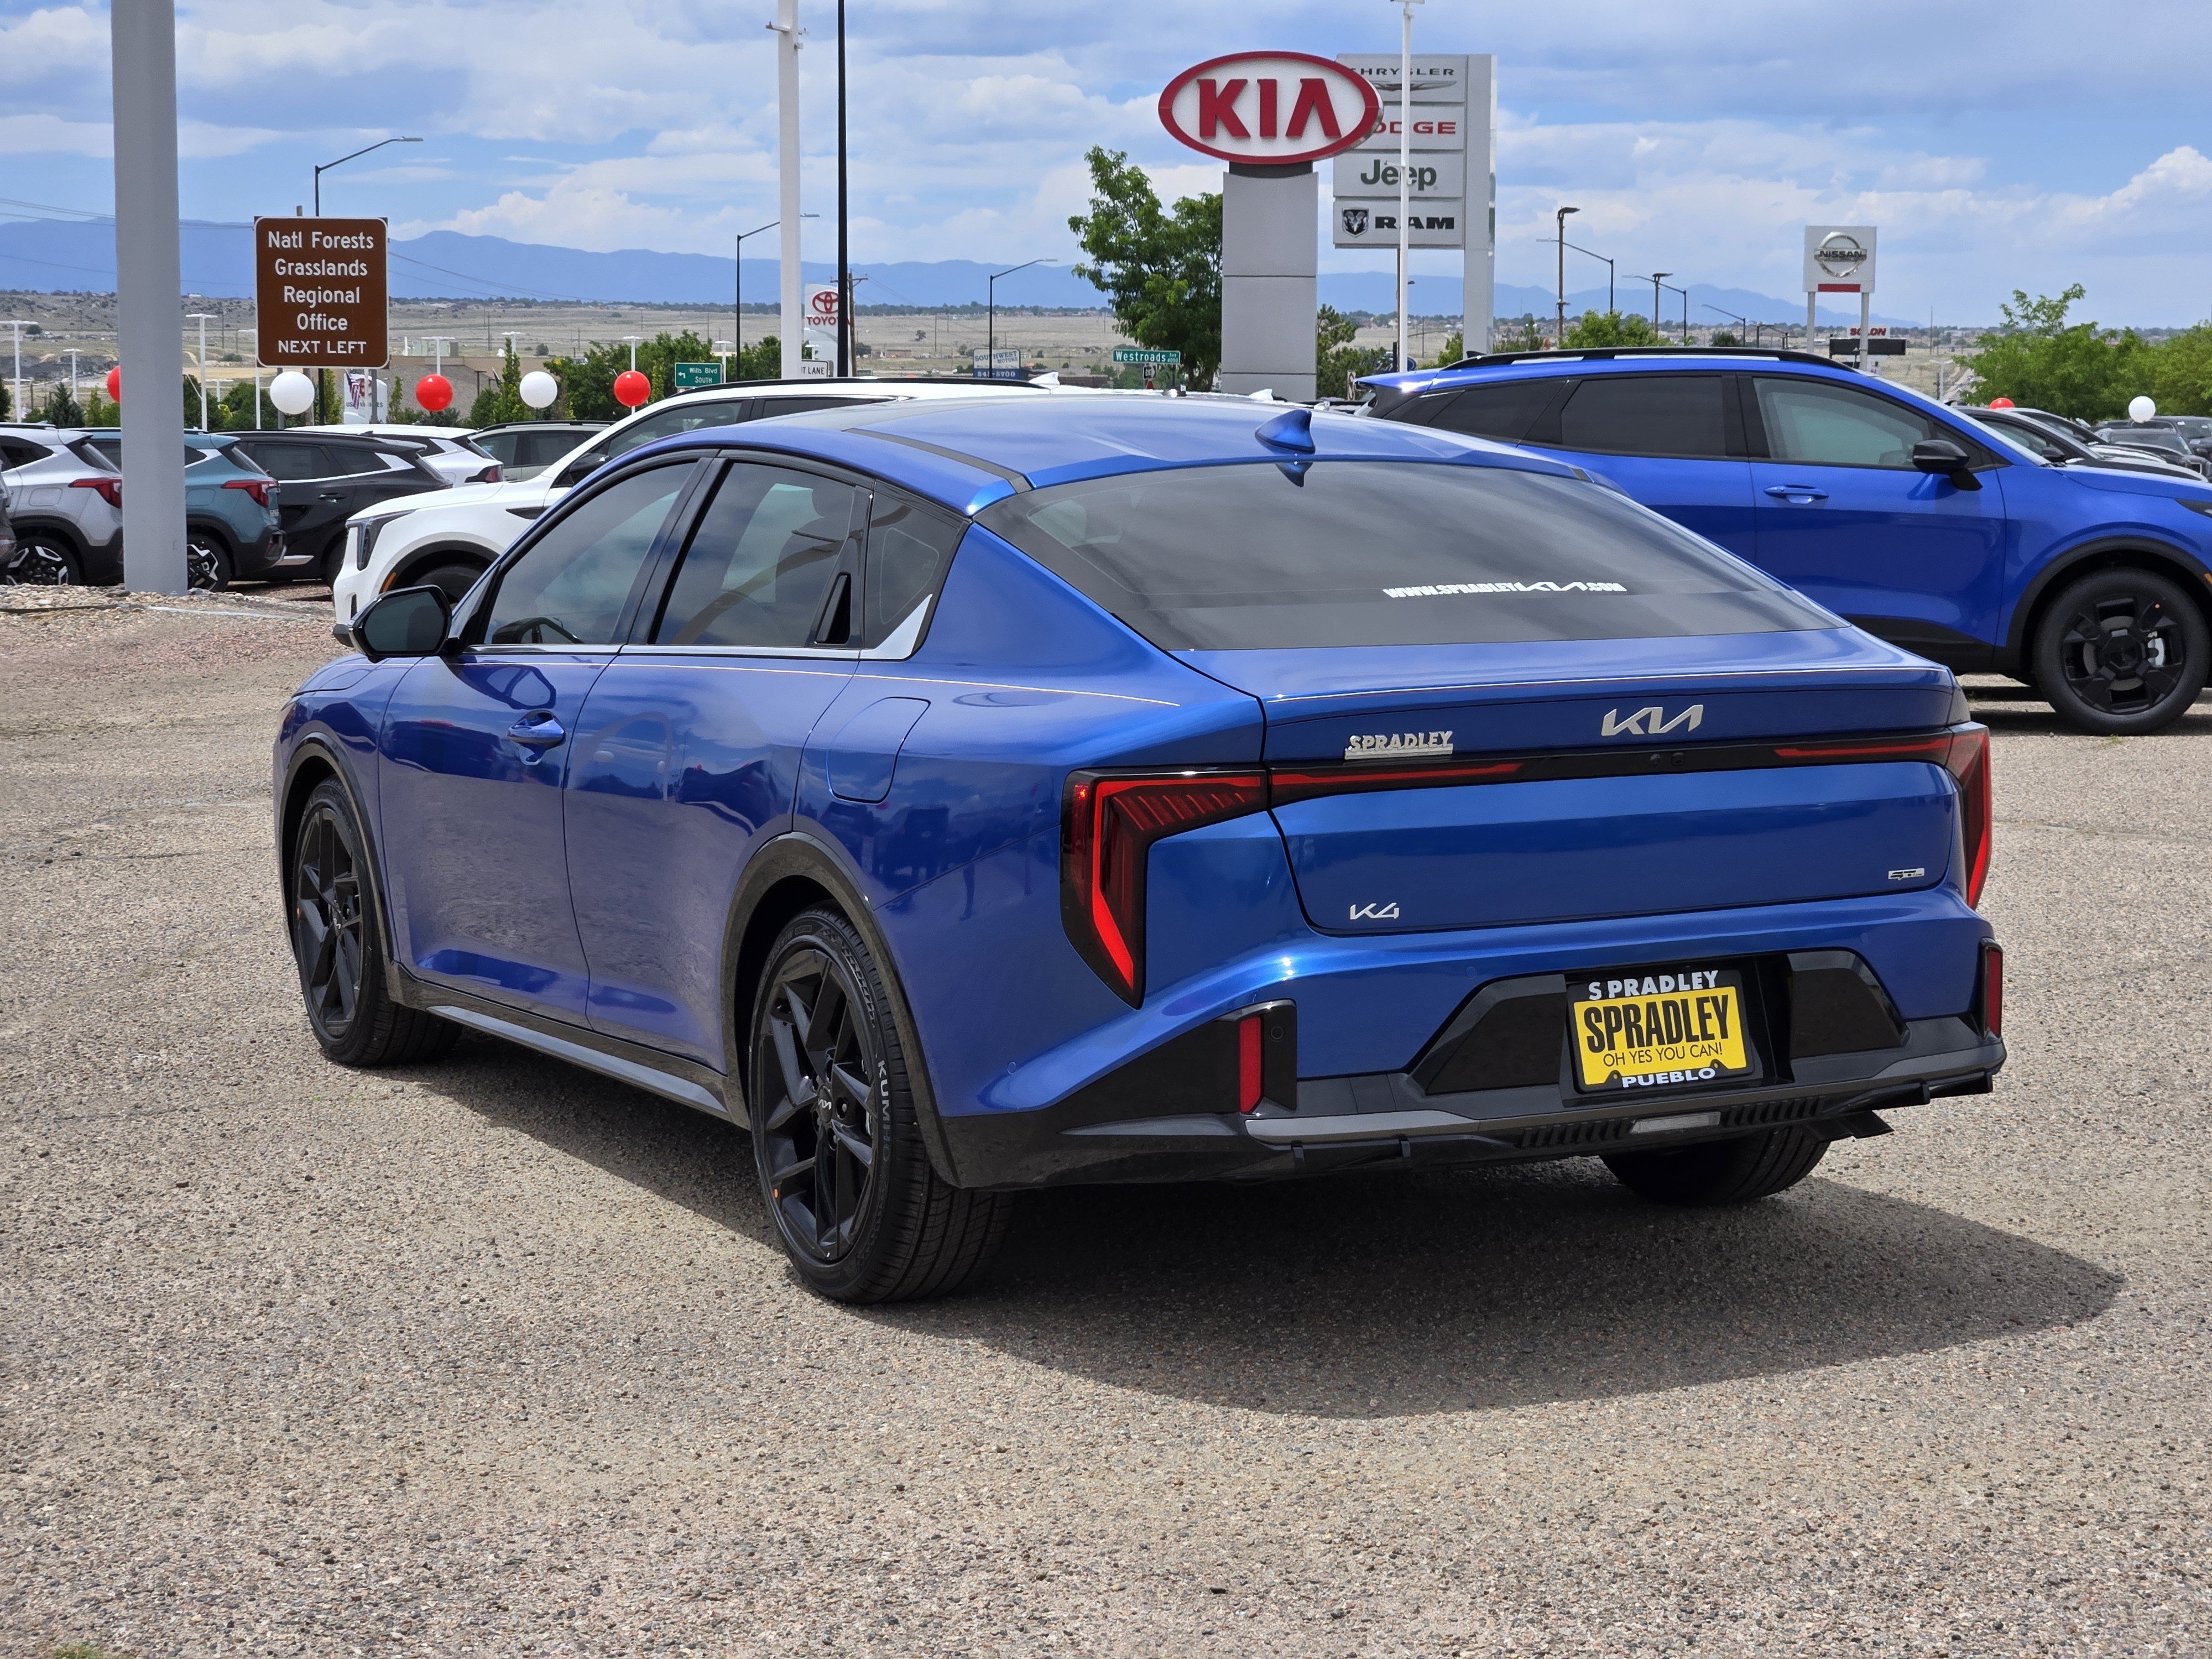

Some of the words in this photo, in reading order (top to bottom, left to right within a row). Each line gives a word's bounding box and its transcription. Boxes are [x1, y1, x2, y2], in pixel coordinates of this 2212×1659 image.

[1197, 78, 1342, 138] KIA
[1374, 121, 1456, 134] ODGE
[1360, 159, 1437, 191] Jeep
[1375, 216, 1454, 229] RAM
[268, 231, 302, 248] Natl
[312, 231, 374, 249] Forests
[275, 258, 368, 276] Grasslands
[284, 285, 360, 309] Regional
[296, 312, 348, 331] Office
[806, 316, 851, 326] TOYO
[278, 340, 321, 353] NEXT
[327, 340, 367, 354] LEFT
[975, 351, 1017, 362] SOUHWEST
[1115, 351, 1166, 362] Westroads
[808, 366, 825, 375] LANE
[1601, 704, 1704, 736] KIA
[1348, 731, 1453, 752] SPRADLEY
[1350, 902, 1400, 920] K4
[1588, 969, 1719, 1000] SPRADLEY
[1583, 994, 1729, 1053] SPRADLEY
[1603, 1053, 1625, 1067] OH
[1629, 1050, 1652, 1064] YES
[1655, 1046, 1686, 1061] YOU
[1690, 1042, 1723, 1058] CAN!
[1621, 1067, 1716, 1088] PUEBLO
[878, 1060, 891, 1162] KUMHO
